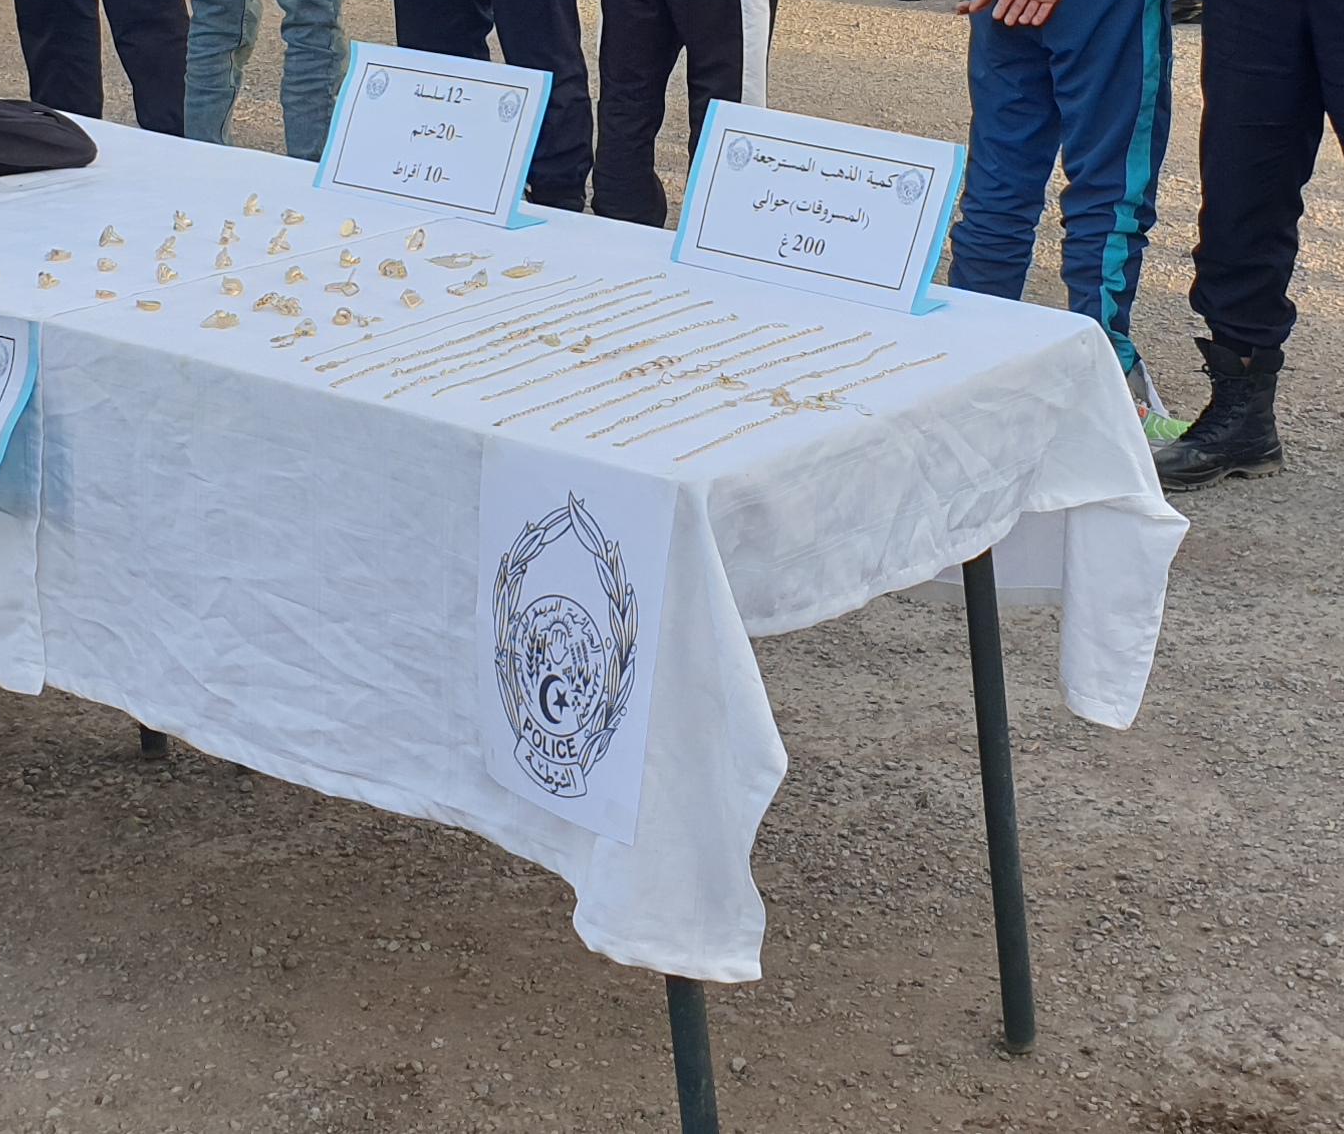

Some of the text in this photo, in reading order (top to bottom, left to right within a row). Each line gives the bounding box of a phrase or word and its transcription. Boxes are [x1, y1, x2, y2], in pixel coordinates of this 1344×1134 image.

[753, 148, 900, 189] كمية الذهب المسترجعة
[523, 716, 578, 759] POLICE
[524, 749, 577, 794] الشرطة
